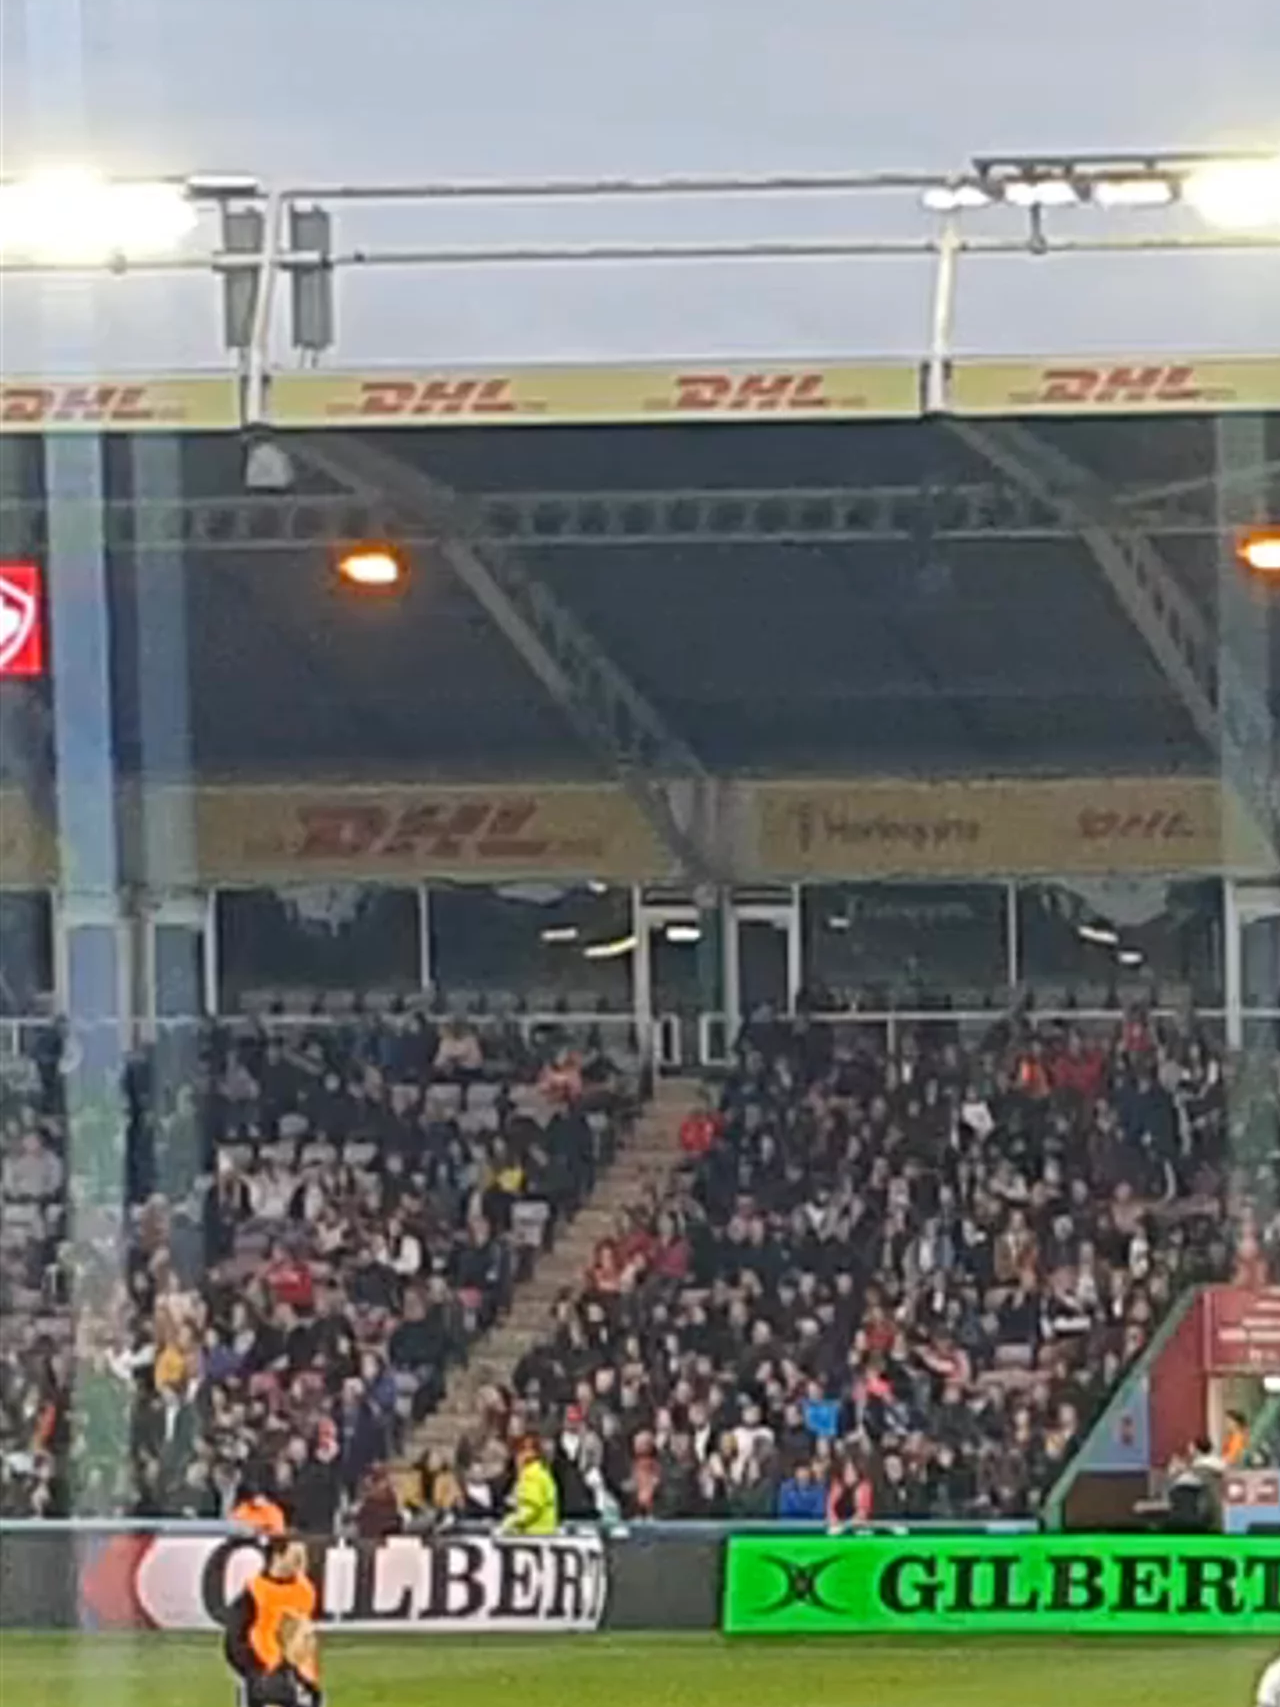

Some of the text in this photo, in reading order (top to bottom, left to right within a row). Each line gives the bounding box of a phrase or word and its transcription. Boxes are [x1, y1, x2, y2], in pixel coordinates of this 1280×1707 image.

[362, 380, 515, 413] DHL
[675, 375, 828, 410] DHL
[1042, 368, 1200, 401] DHL
[1, 387, 150, 419] DHL
[300, 801, 548, 857] DHL
